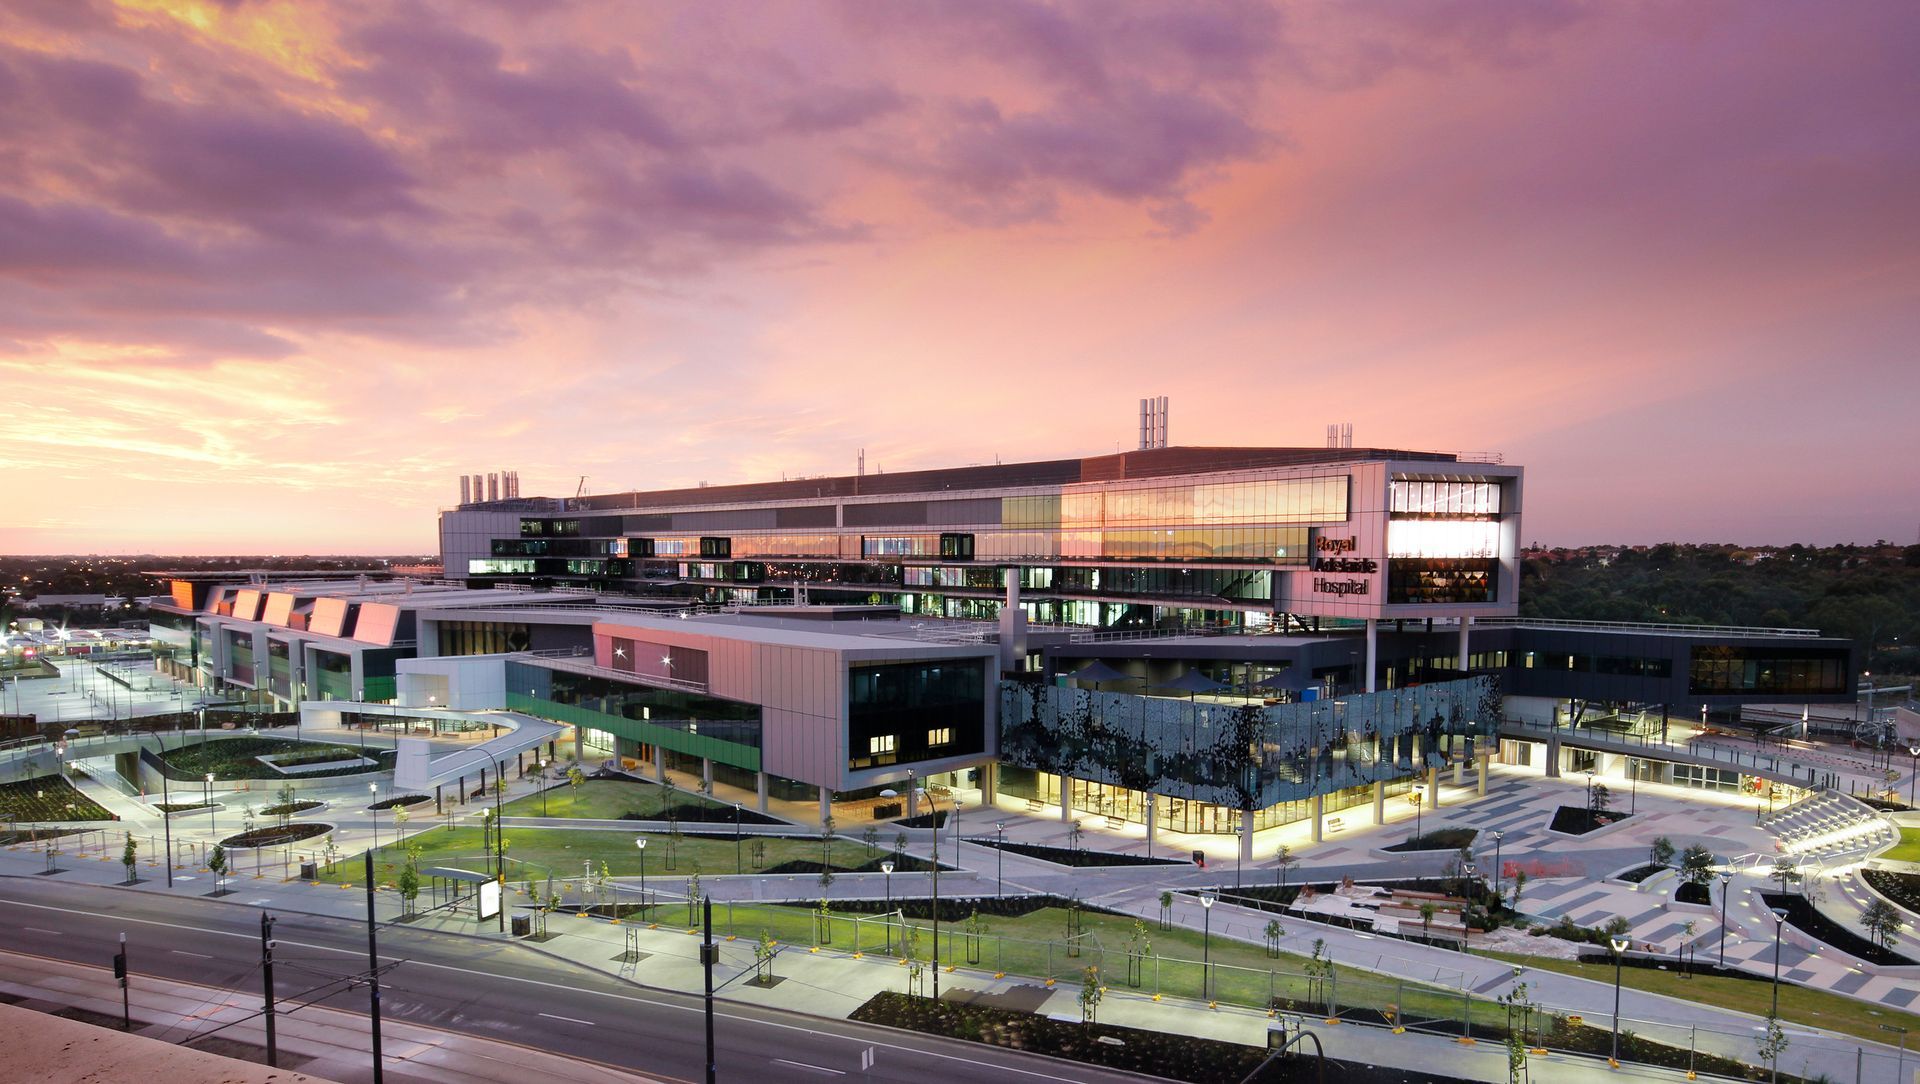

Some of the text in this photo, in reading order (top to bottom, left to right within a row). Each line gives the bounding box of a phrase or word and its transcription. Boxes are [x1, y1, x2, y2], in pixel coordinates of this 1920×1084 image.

[1316, 536, 1356, 555] Royal
[1314, 558, 1377, 573] Adelaide
[1314, 578, 1368, 597] Hospital
